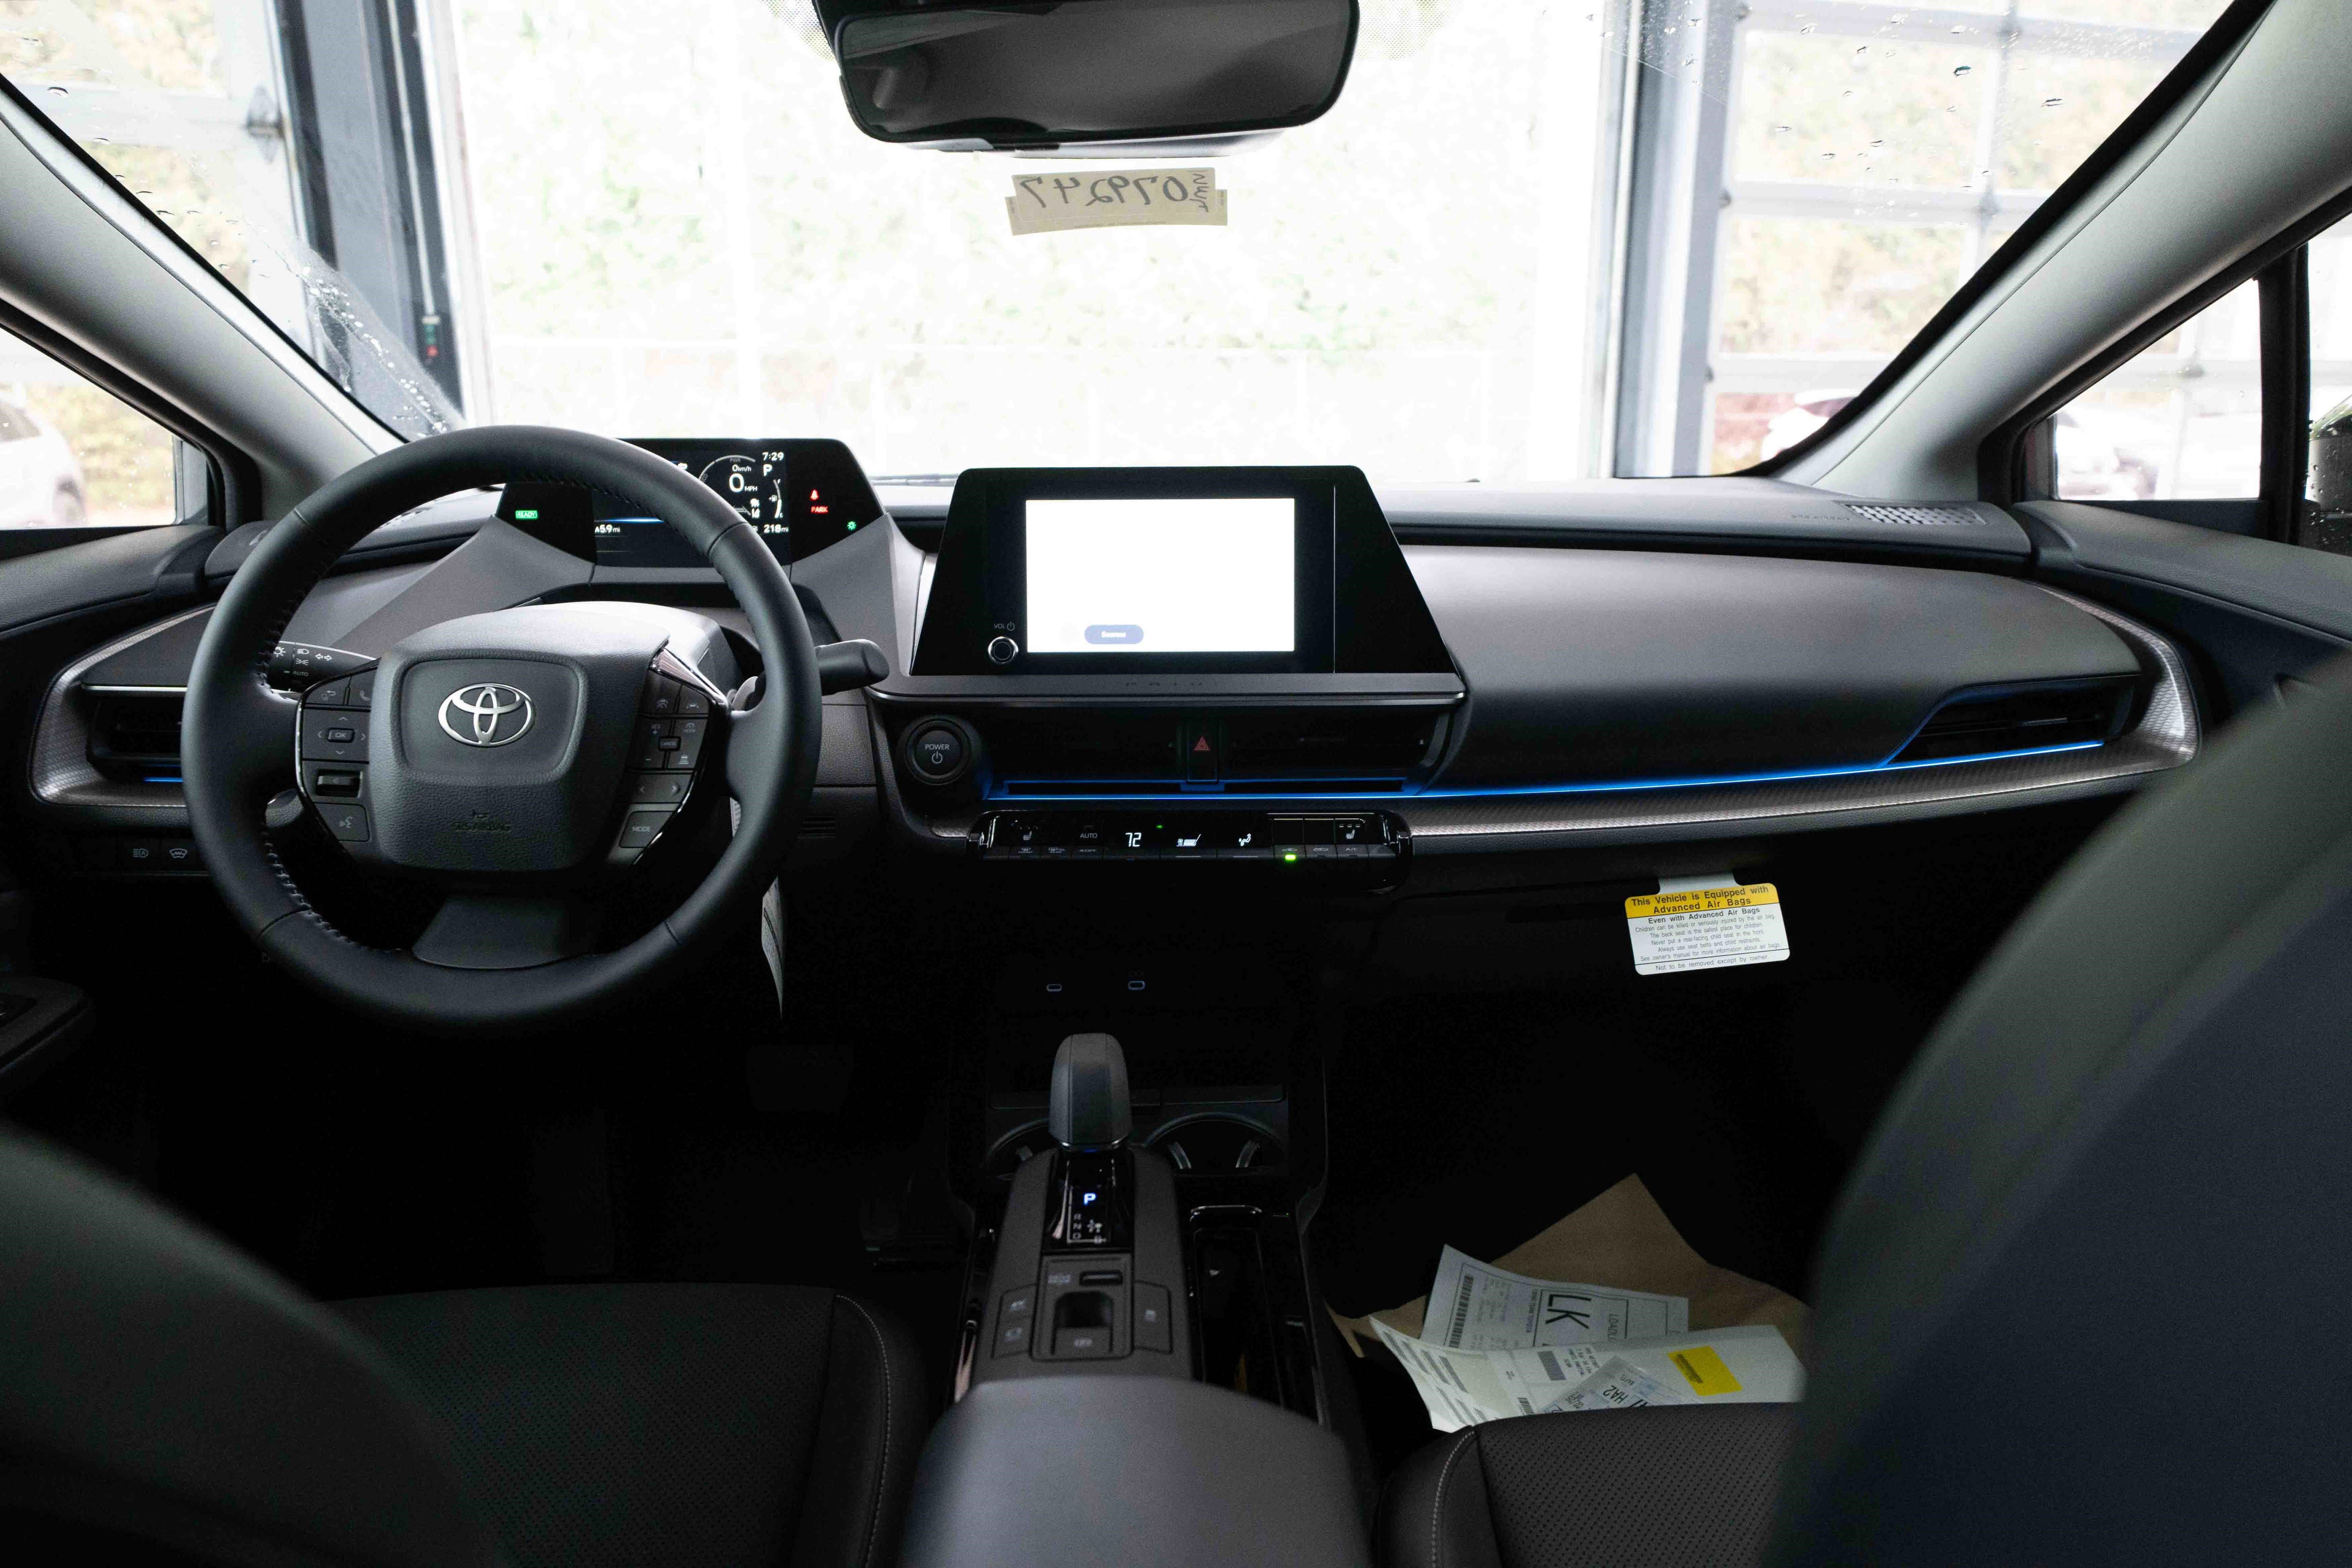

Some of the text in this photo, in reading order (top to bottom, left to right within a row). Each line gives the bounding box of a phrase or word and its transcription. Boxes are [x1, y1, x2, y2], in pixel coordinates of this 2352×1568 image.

[762, 452, 784, 461] 7:29
[763, 463, 773, 477] P
[1125, 832, 1142, 847] 72
[1631, 898, 1650, 906] This
[1655, 894, 1687, 904] Vehicle
[1704, 888, 1745, 899] Equipped
[1750, 886, 1769, 894] with
[1654, 902, 1700, 914] Advanced
[1727, 898, 1751, 906] Bags
[1689, 911, 1724, 920] Advanced
[1083, 1192, 1097, 1205] P
[1545, 1294, 1592, 1329] LK
